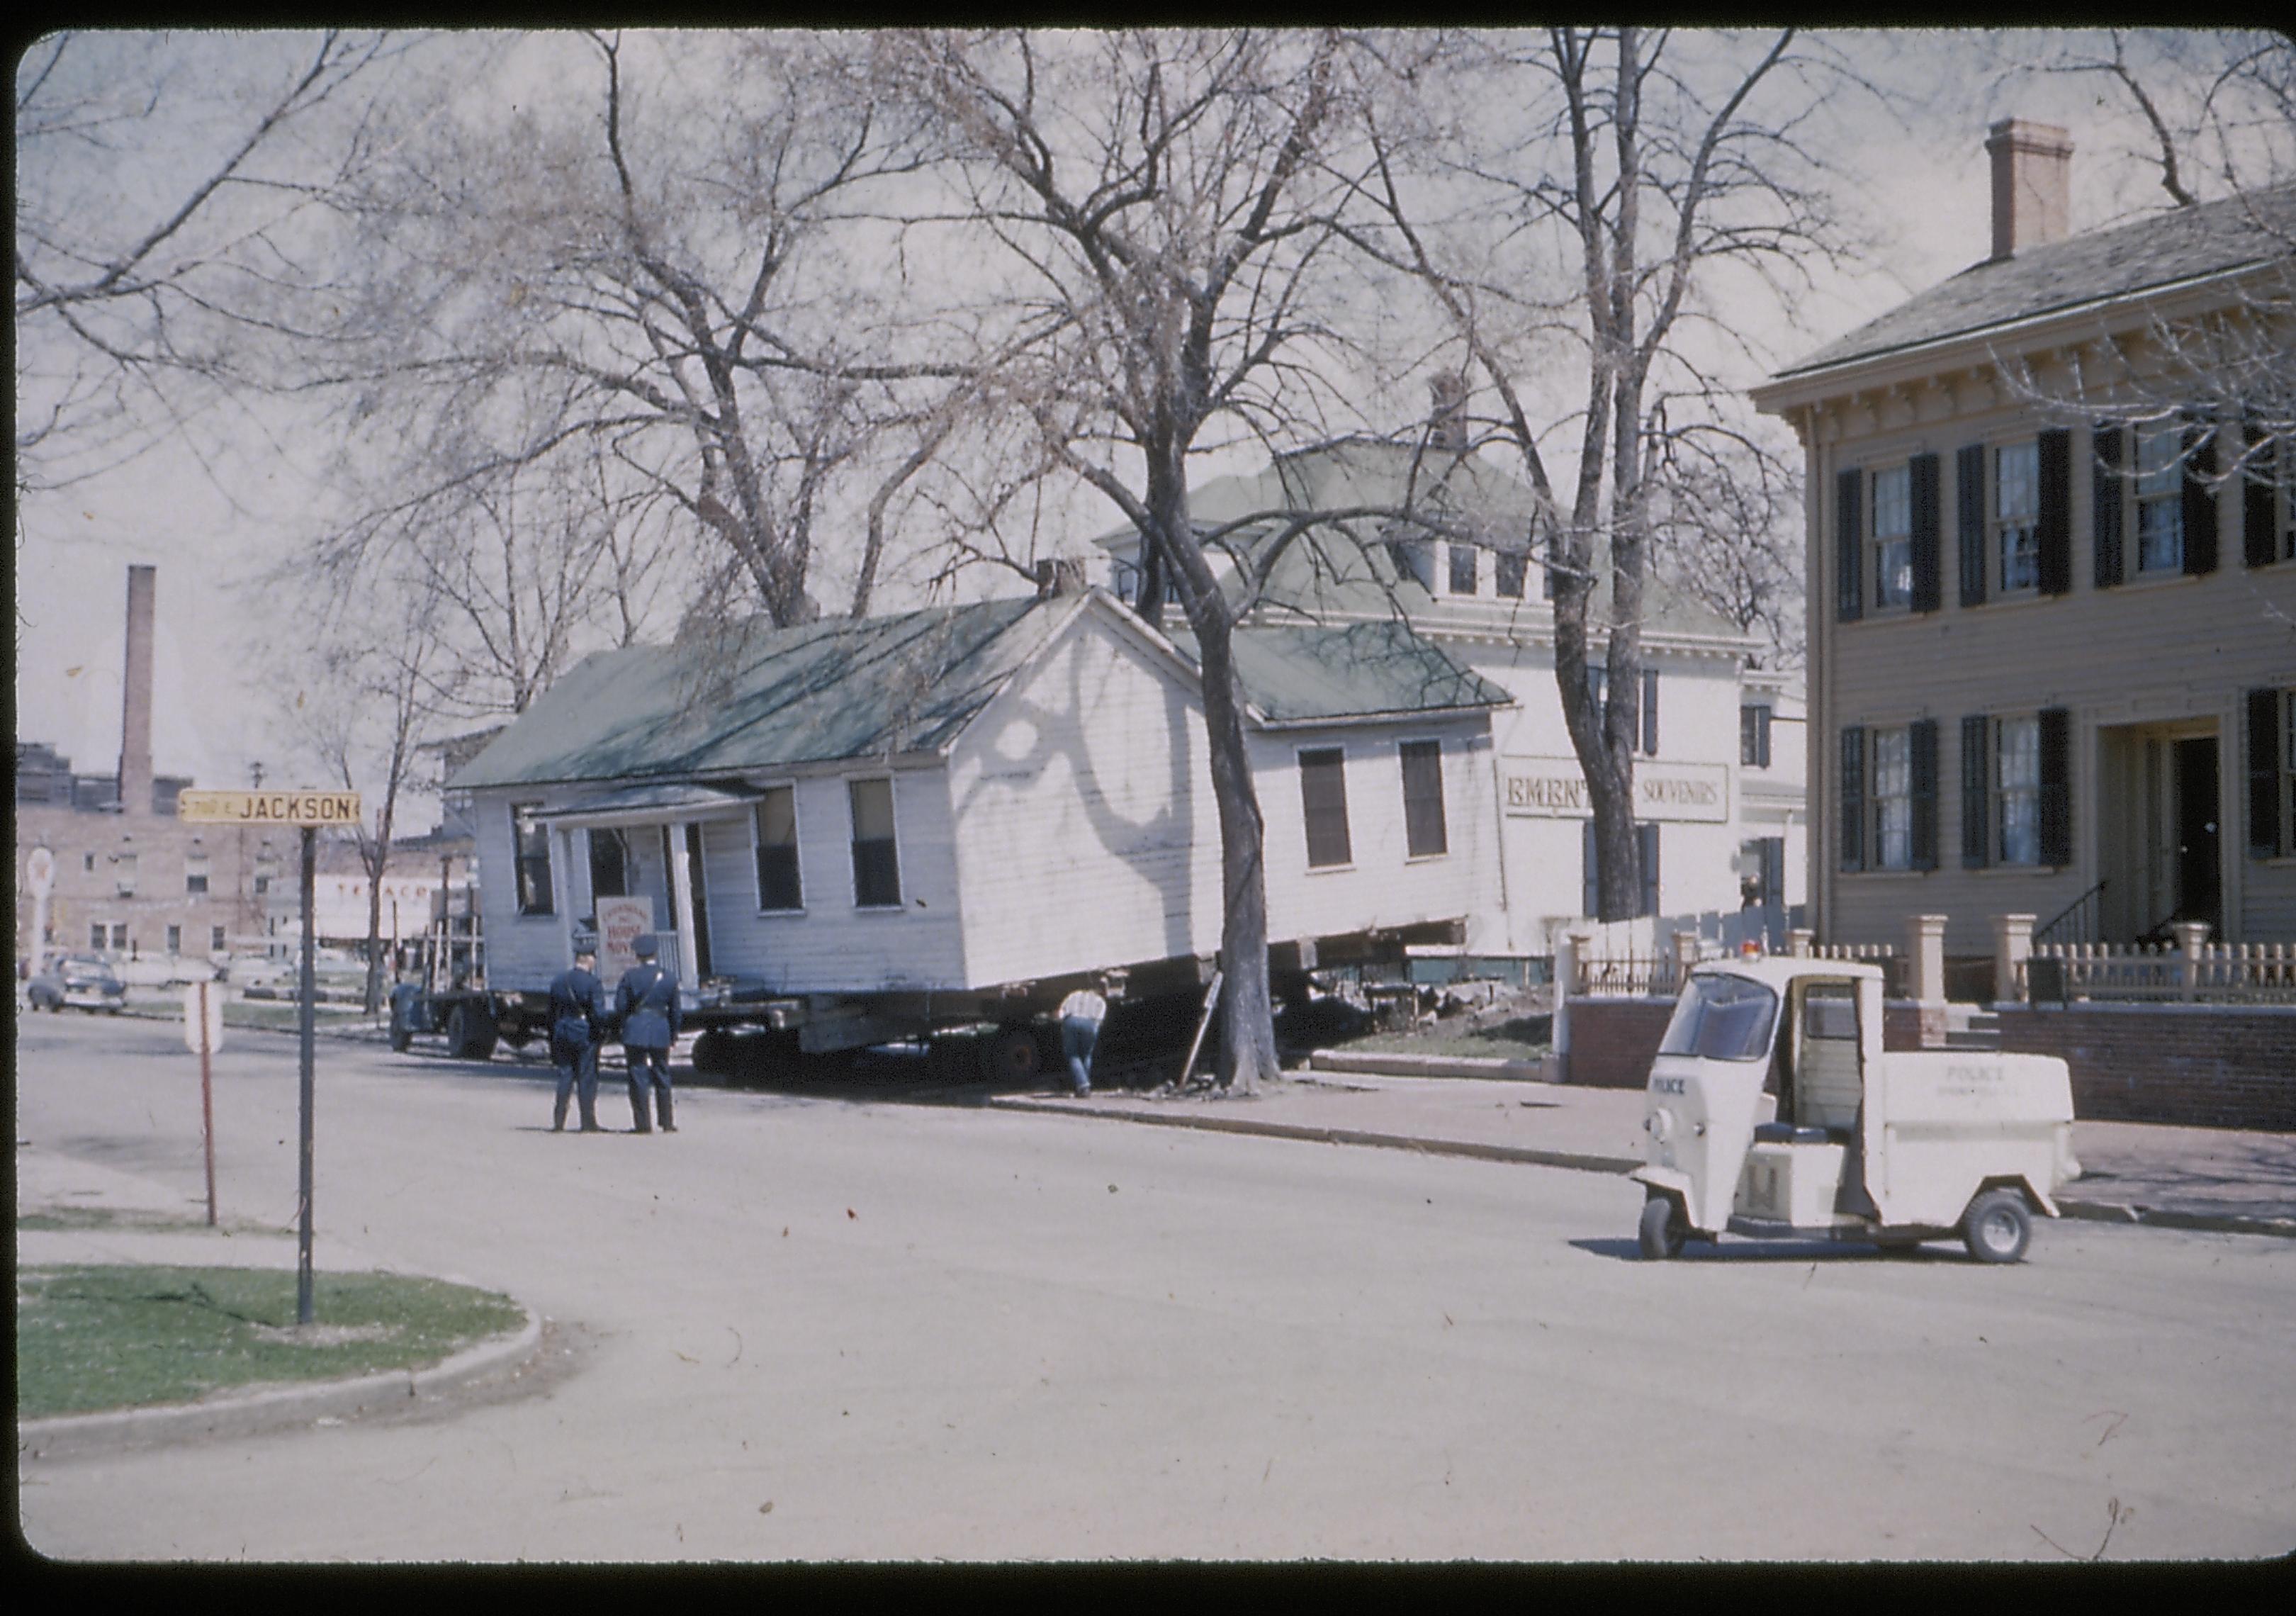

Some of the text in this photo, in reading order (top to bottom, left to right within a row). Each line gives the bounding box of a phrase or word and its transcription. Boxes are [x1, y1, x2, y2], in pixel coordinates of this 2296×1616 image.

[240, 797, 350, 819] JACKSON
[338, 883, 427, 897] TEACO
[1947, 1066, 2003, 1082] POLICE
[1653, 1078, 1685, 1094] POLICE
